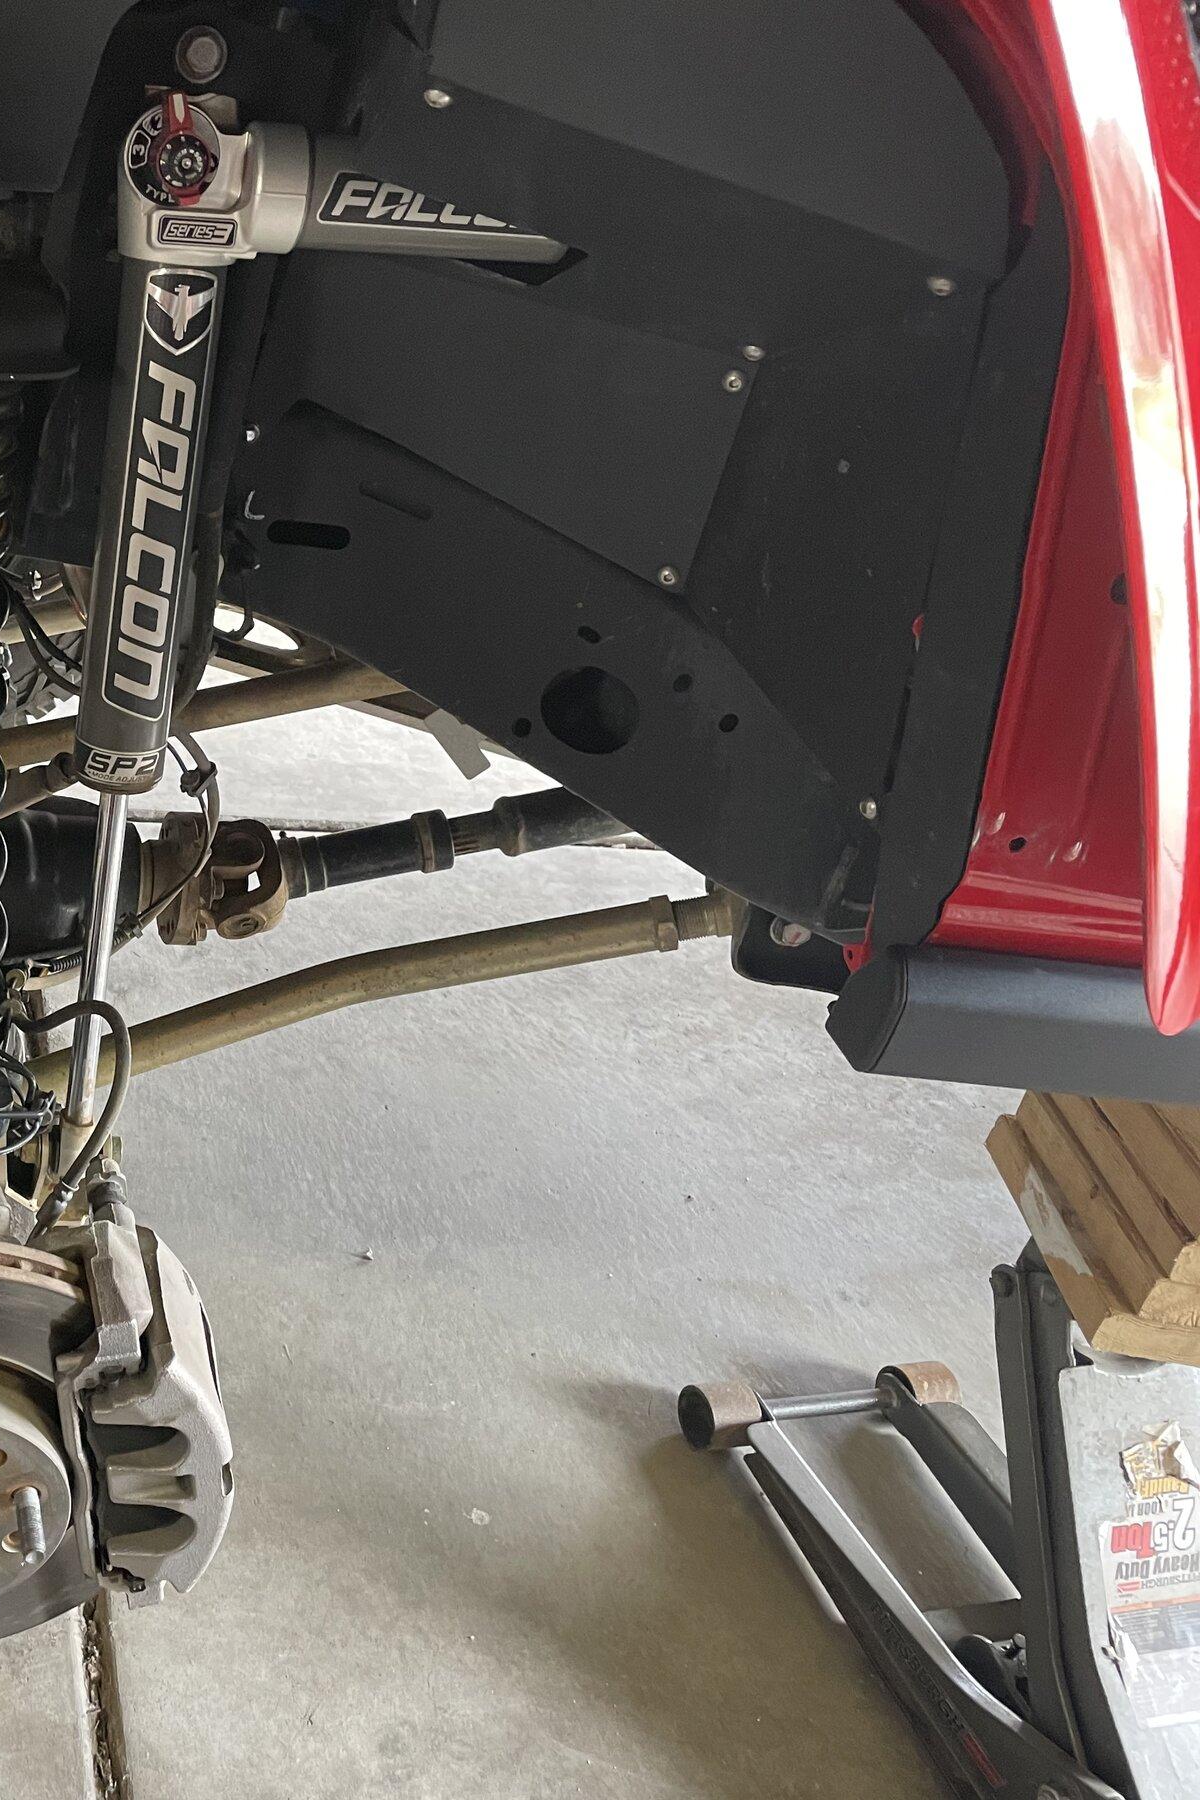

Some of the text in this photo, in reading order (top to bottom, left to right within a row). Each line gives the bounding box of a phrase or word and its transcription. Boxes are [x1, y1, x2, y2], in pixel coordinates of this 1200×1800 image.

[113, 360, 197, 701] FALCON
[87, 753, 158, 776] SP2
[1114, 1553, 1200, 1581] Heavy Duty
